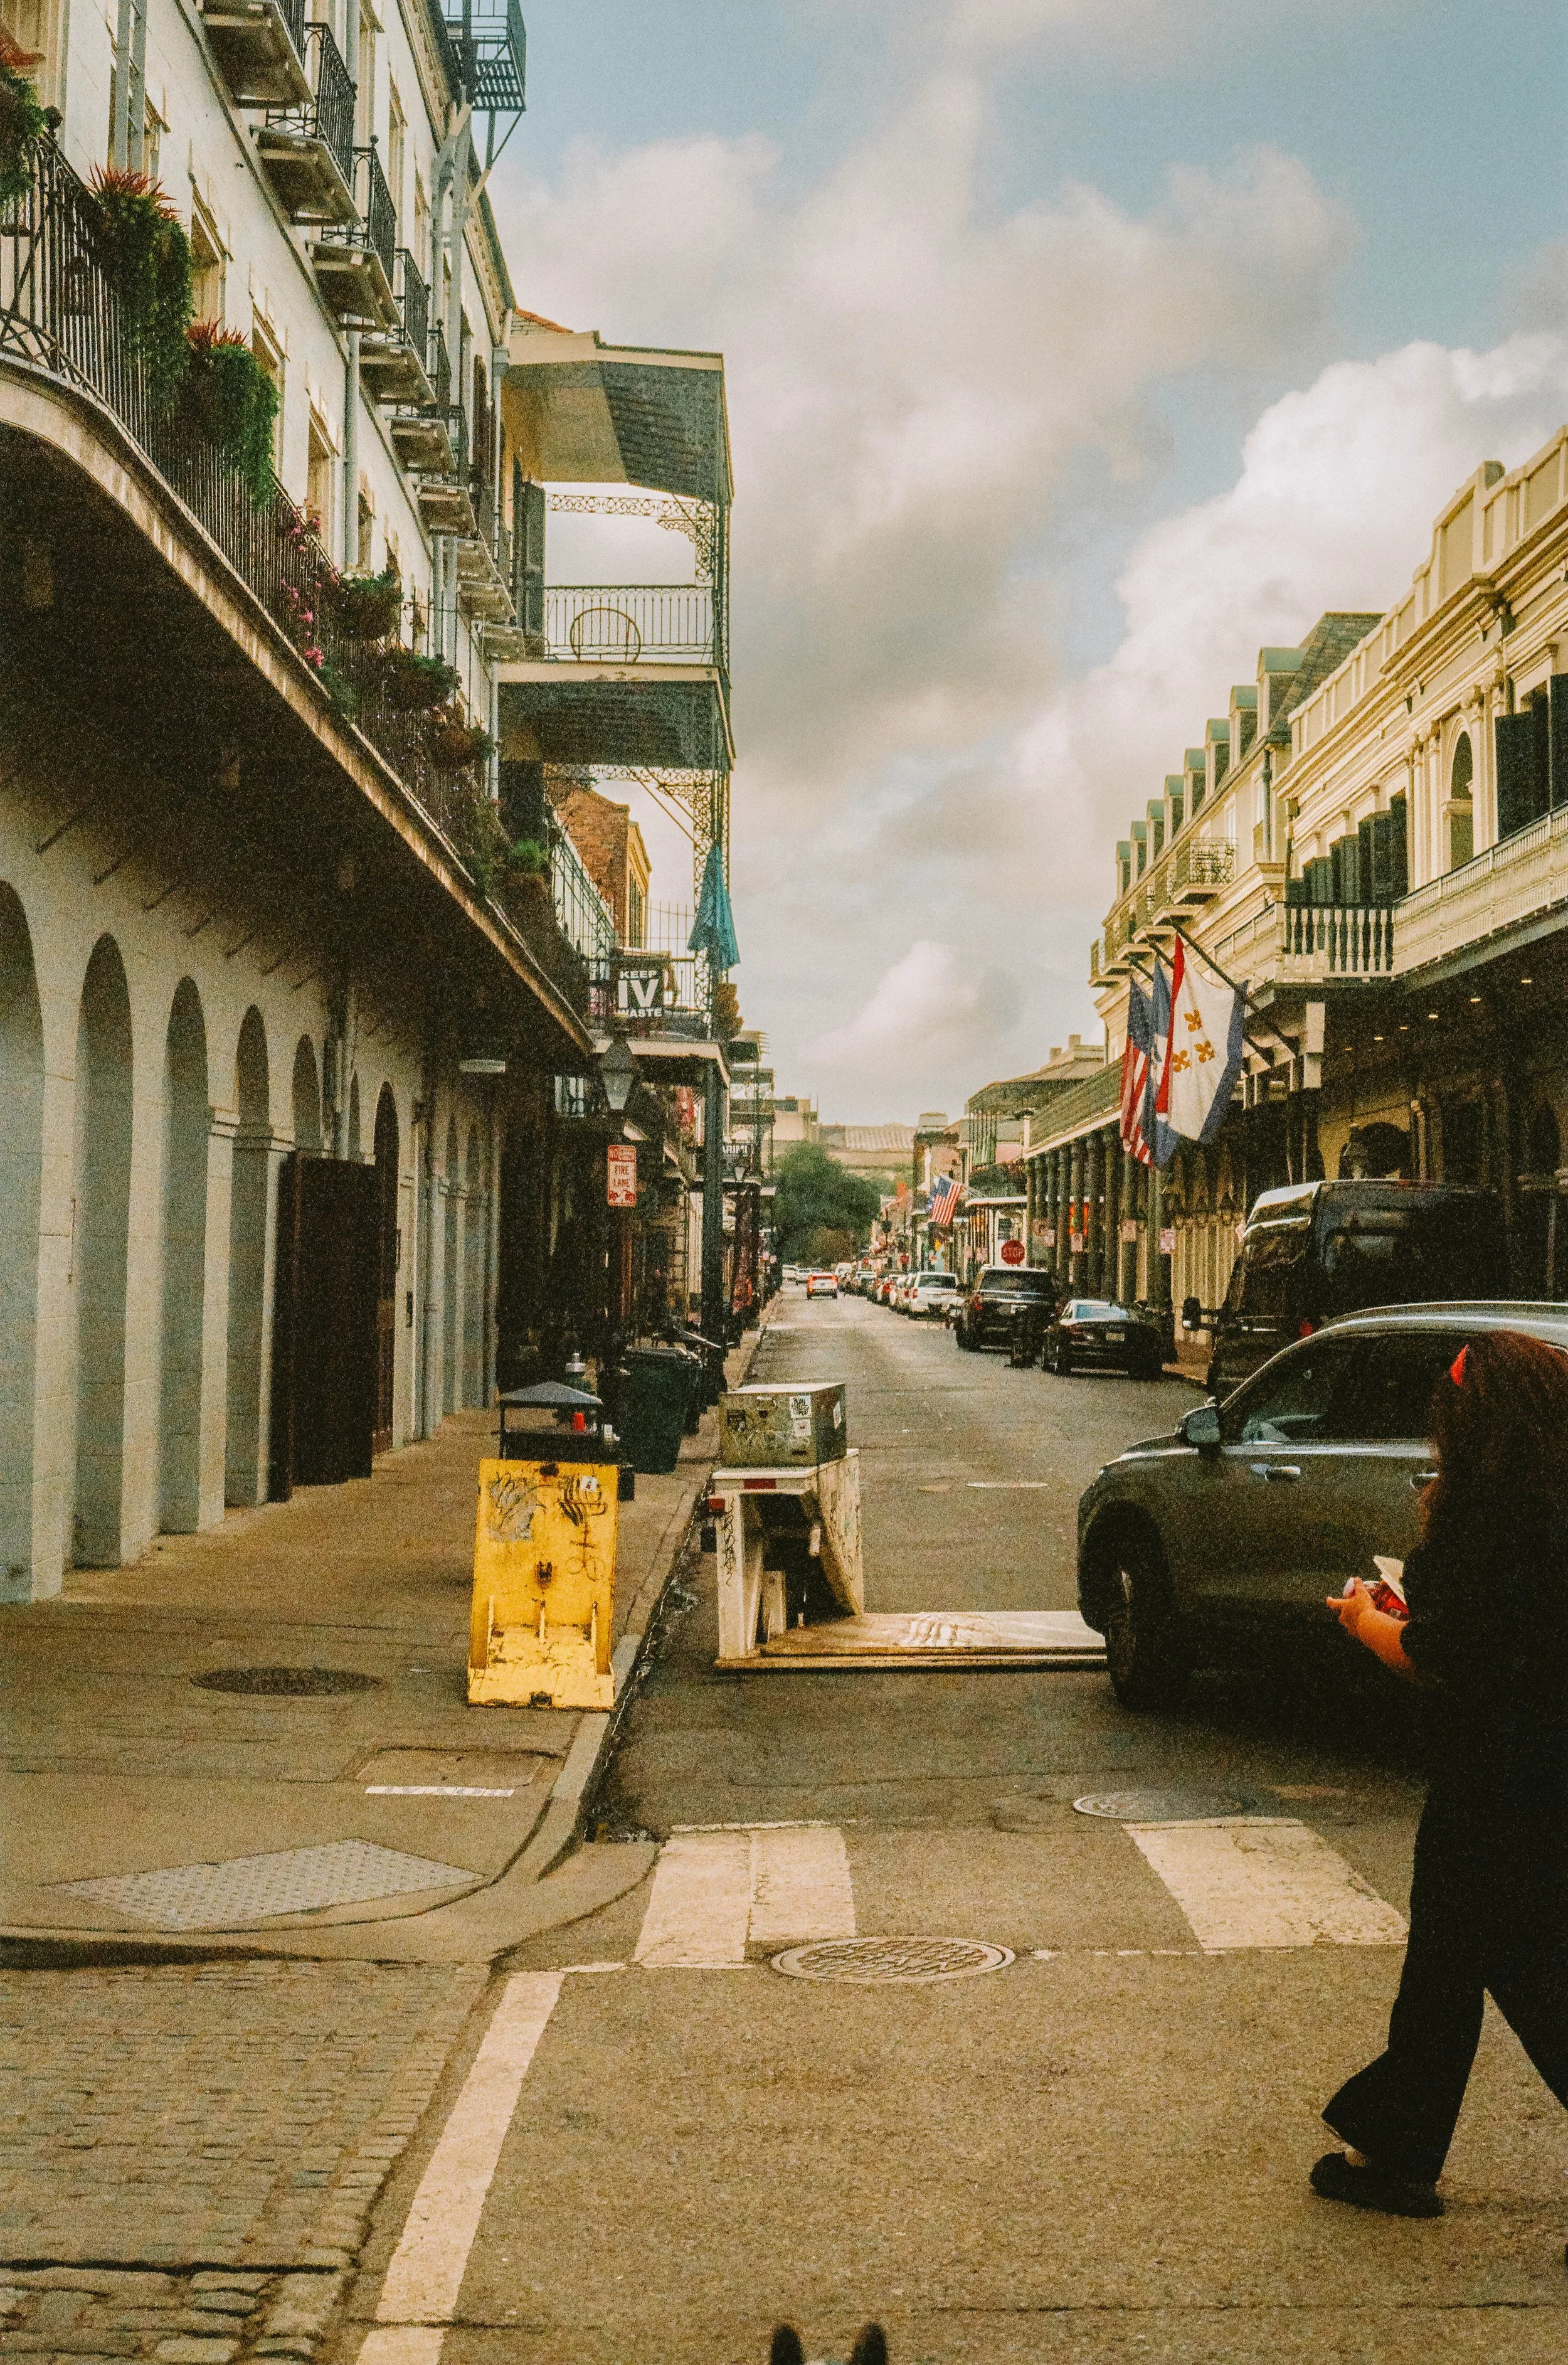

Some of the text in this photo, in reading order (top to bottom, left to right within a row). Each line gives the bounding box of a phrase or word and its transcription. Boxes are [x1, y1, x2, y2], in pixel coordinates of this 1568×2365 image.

[620, 970, 657, 979] KEEP
[618, 979, 659, 1008] IV
[615, 1165, 630, 1175] FIRE
[613, 1179, 630, 1188] LANE
[1002, 1247, 1024, 1258] STOP
